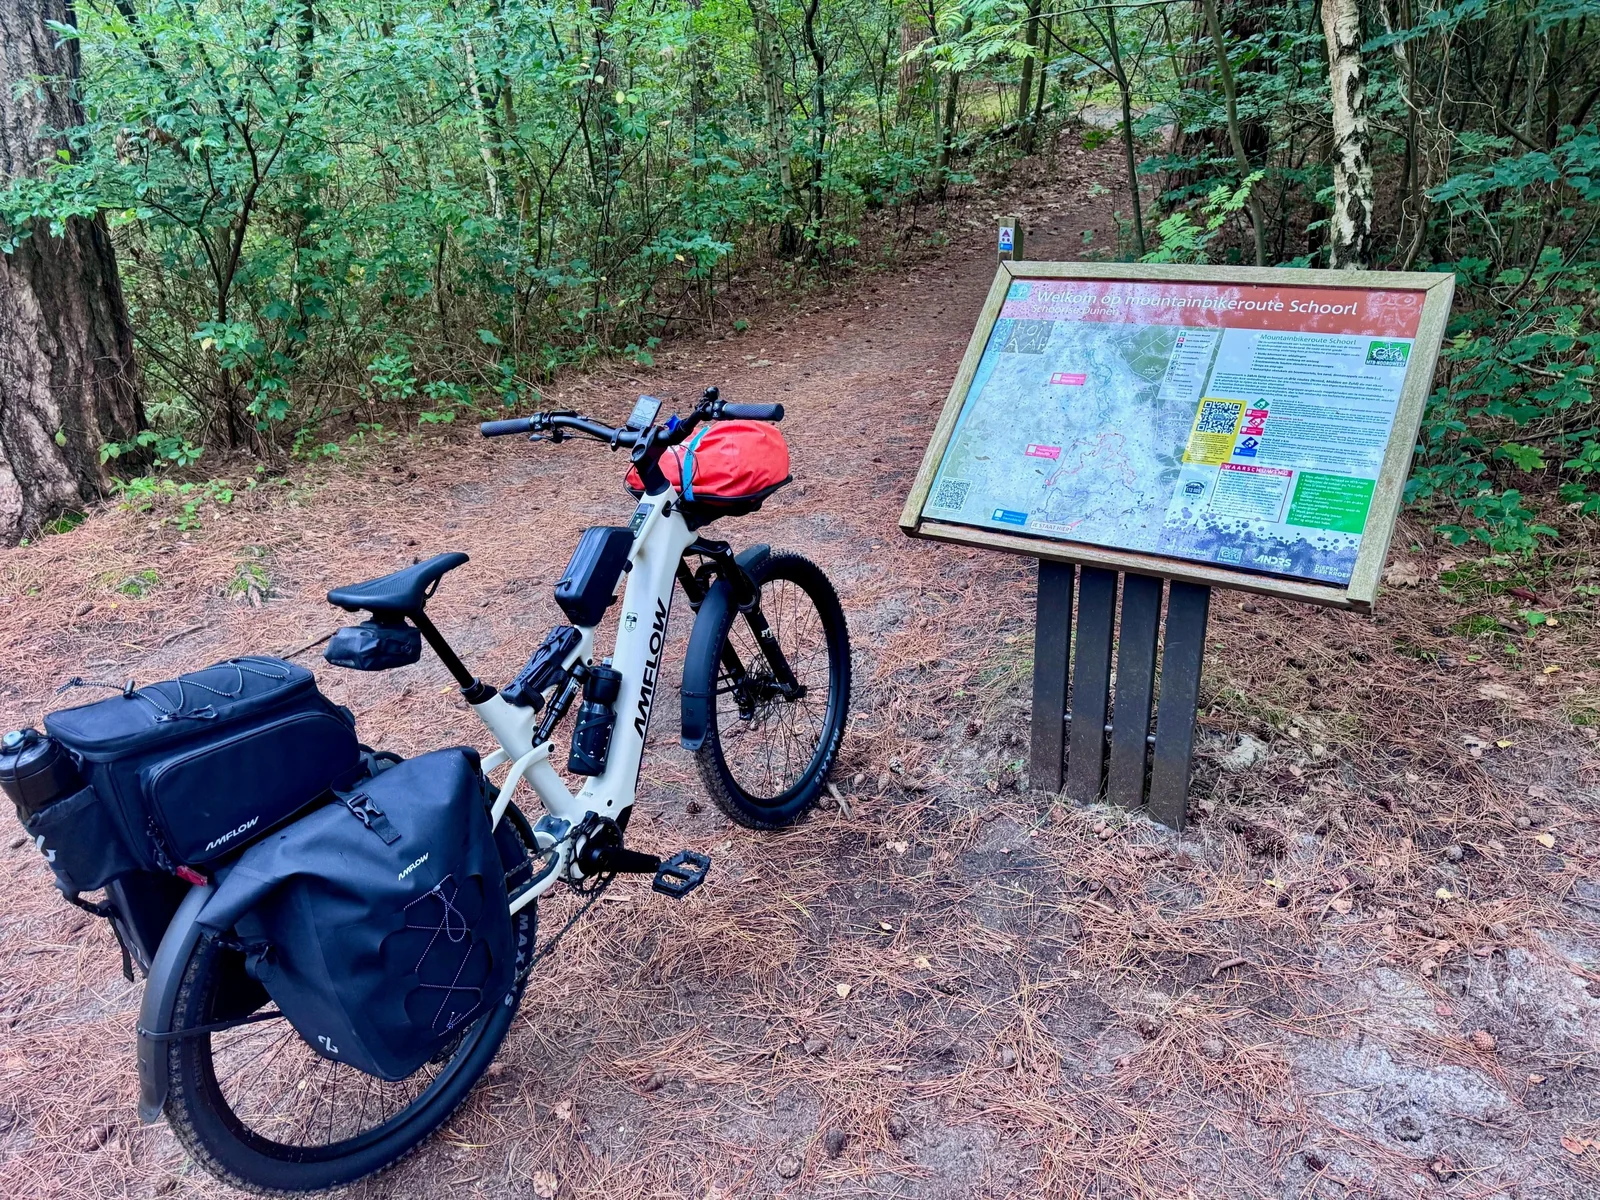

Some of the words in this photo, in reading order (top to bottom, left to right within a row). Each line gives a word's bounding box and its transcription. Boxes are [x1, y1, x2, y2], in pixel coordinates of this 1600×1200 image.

[1036, 291, 1097, 304] Welkom
[1101, 295, 1121, 308] op
[1125, 294, 1284, 312] mountainbikeroute
[1288, 299, 1358, 316] Schoorl
[1259, 333, 1328, 344] Mountainbikeroute
[1328, 335, 1357, 345] Schoorl
[1223, 464, 1290, 477] WAARSCHUWING
[634, 597, 667, 739] AMFLOW
[815, 727, 840, 785] MAXXIS
[205, 815, 260, 852] AMFLOW
[398, 852, 429, 881] AMFLOW
